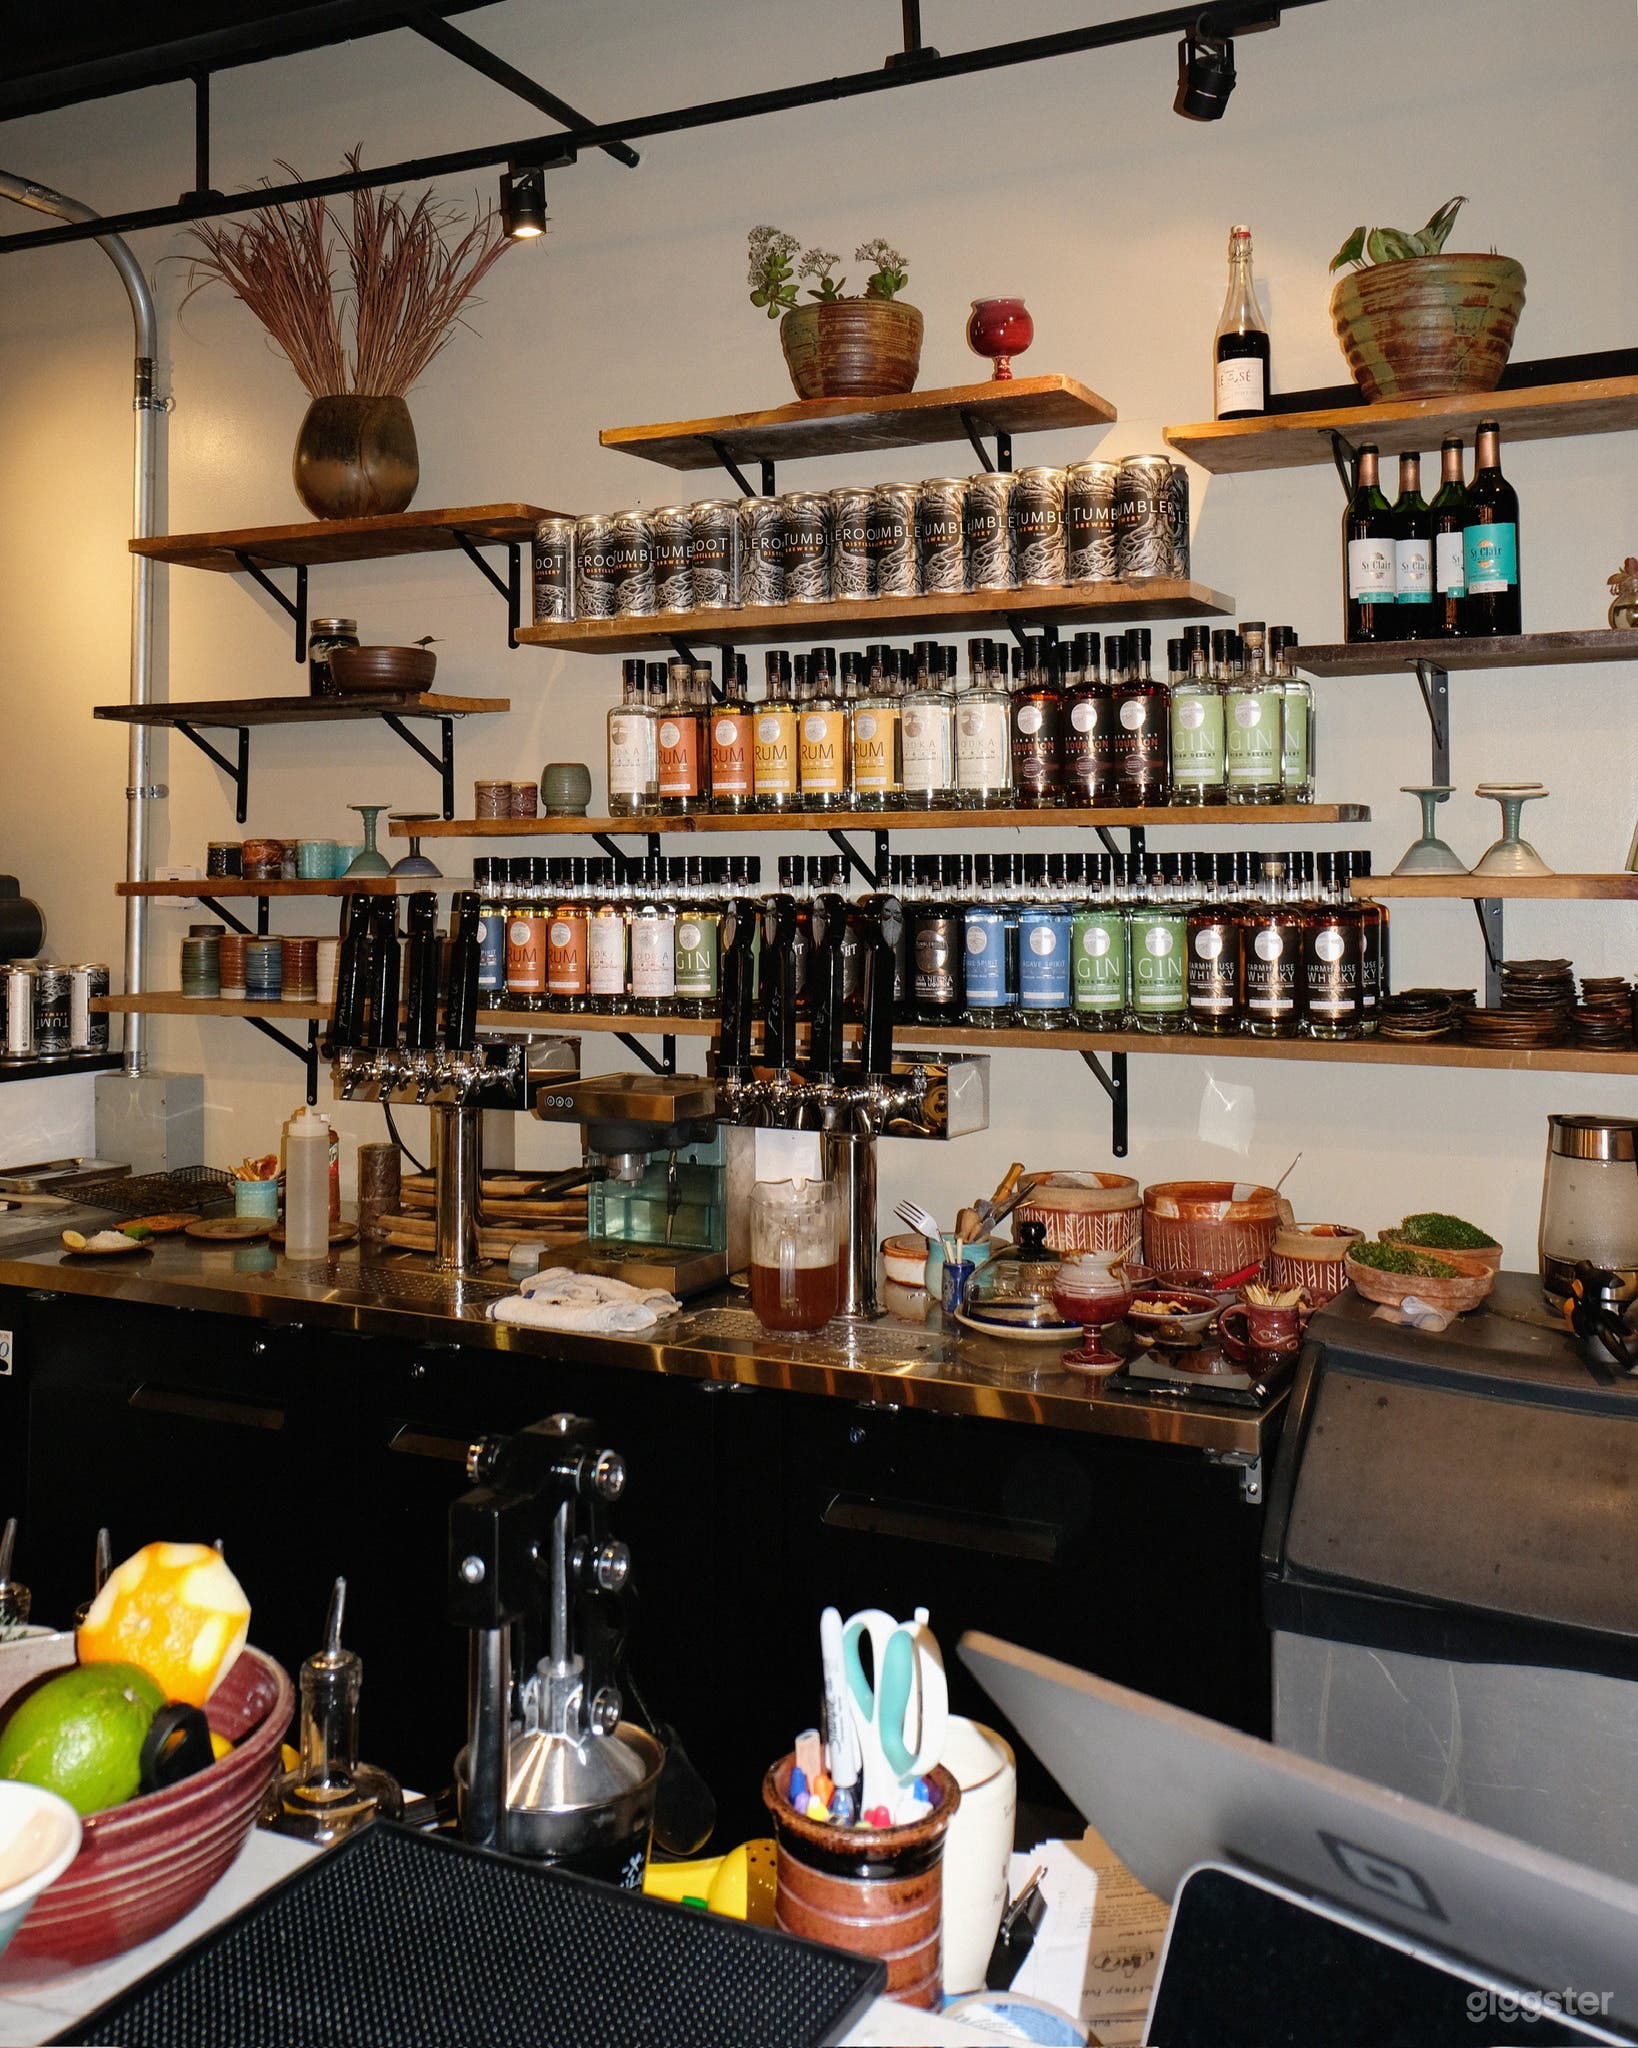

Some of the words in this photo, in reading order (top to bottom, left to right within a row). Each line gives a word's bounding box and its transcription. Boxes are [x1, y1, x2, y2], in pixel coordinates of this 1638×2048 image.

[1373, 560, 1391, 570] Clair
[1012, 741, 1054, 752] BOURON
[1065, 740, 1108, 750] BOURON
[1115, 738, 1158, 748] BOURON
[1174, 731, 1215, 752] GIN
[1229, 729, 1272, 751] GIN
[711, 747, 744, 763] RUM
[755, 744, 787, 761] RUM
[802, 743, 834, 760] RUM
[676, 951, 710, 970] GIN
[1077, 957, 1120, 978] GIN
[1138, 957, 1182, 978] GIN
[1190, 962, 1234, 971] FARMHUSE
[1247, 963, 1294, 972] FARMHUSE
[1307, 964, 1356, 973] FARMHUSE
